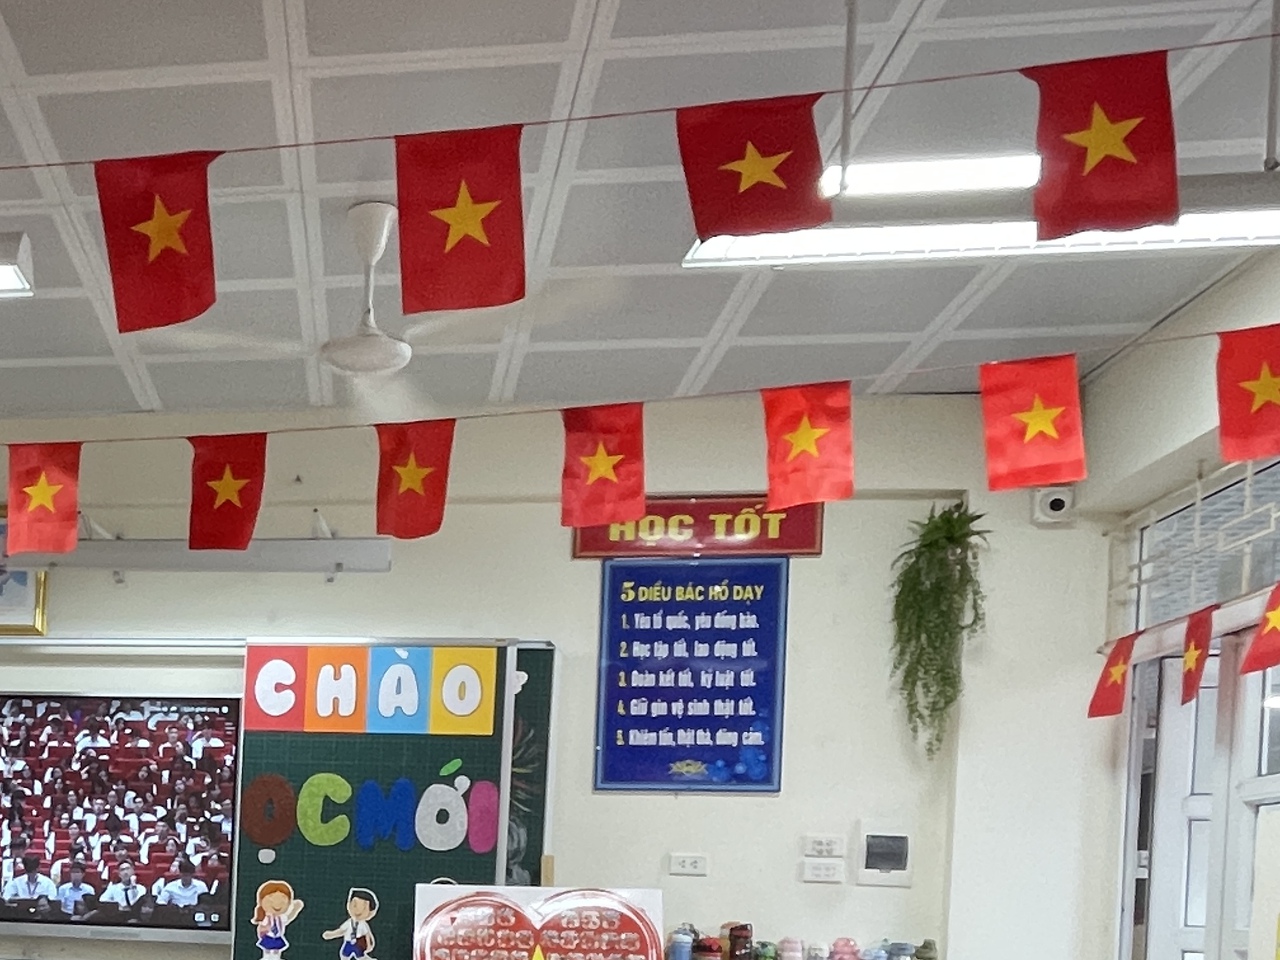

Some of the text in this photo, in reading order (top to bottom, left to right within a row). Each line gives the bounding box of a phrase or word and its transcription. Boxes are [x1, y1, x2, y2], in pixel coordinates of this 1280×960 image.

[609, 504, 787, 546] HỌC TỐT
[620, 581, 635, 602] 5
[675, 582, 705, 601] BÁC
[253, 648, 483, 718] CHÀO
